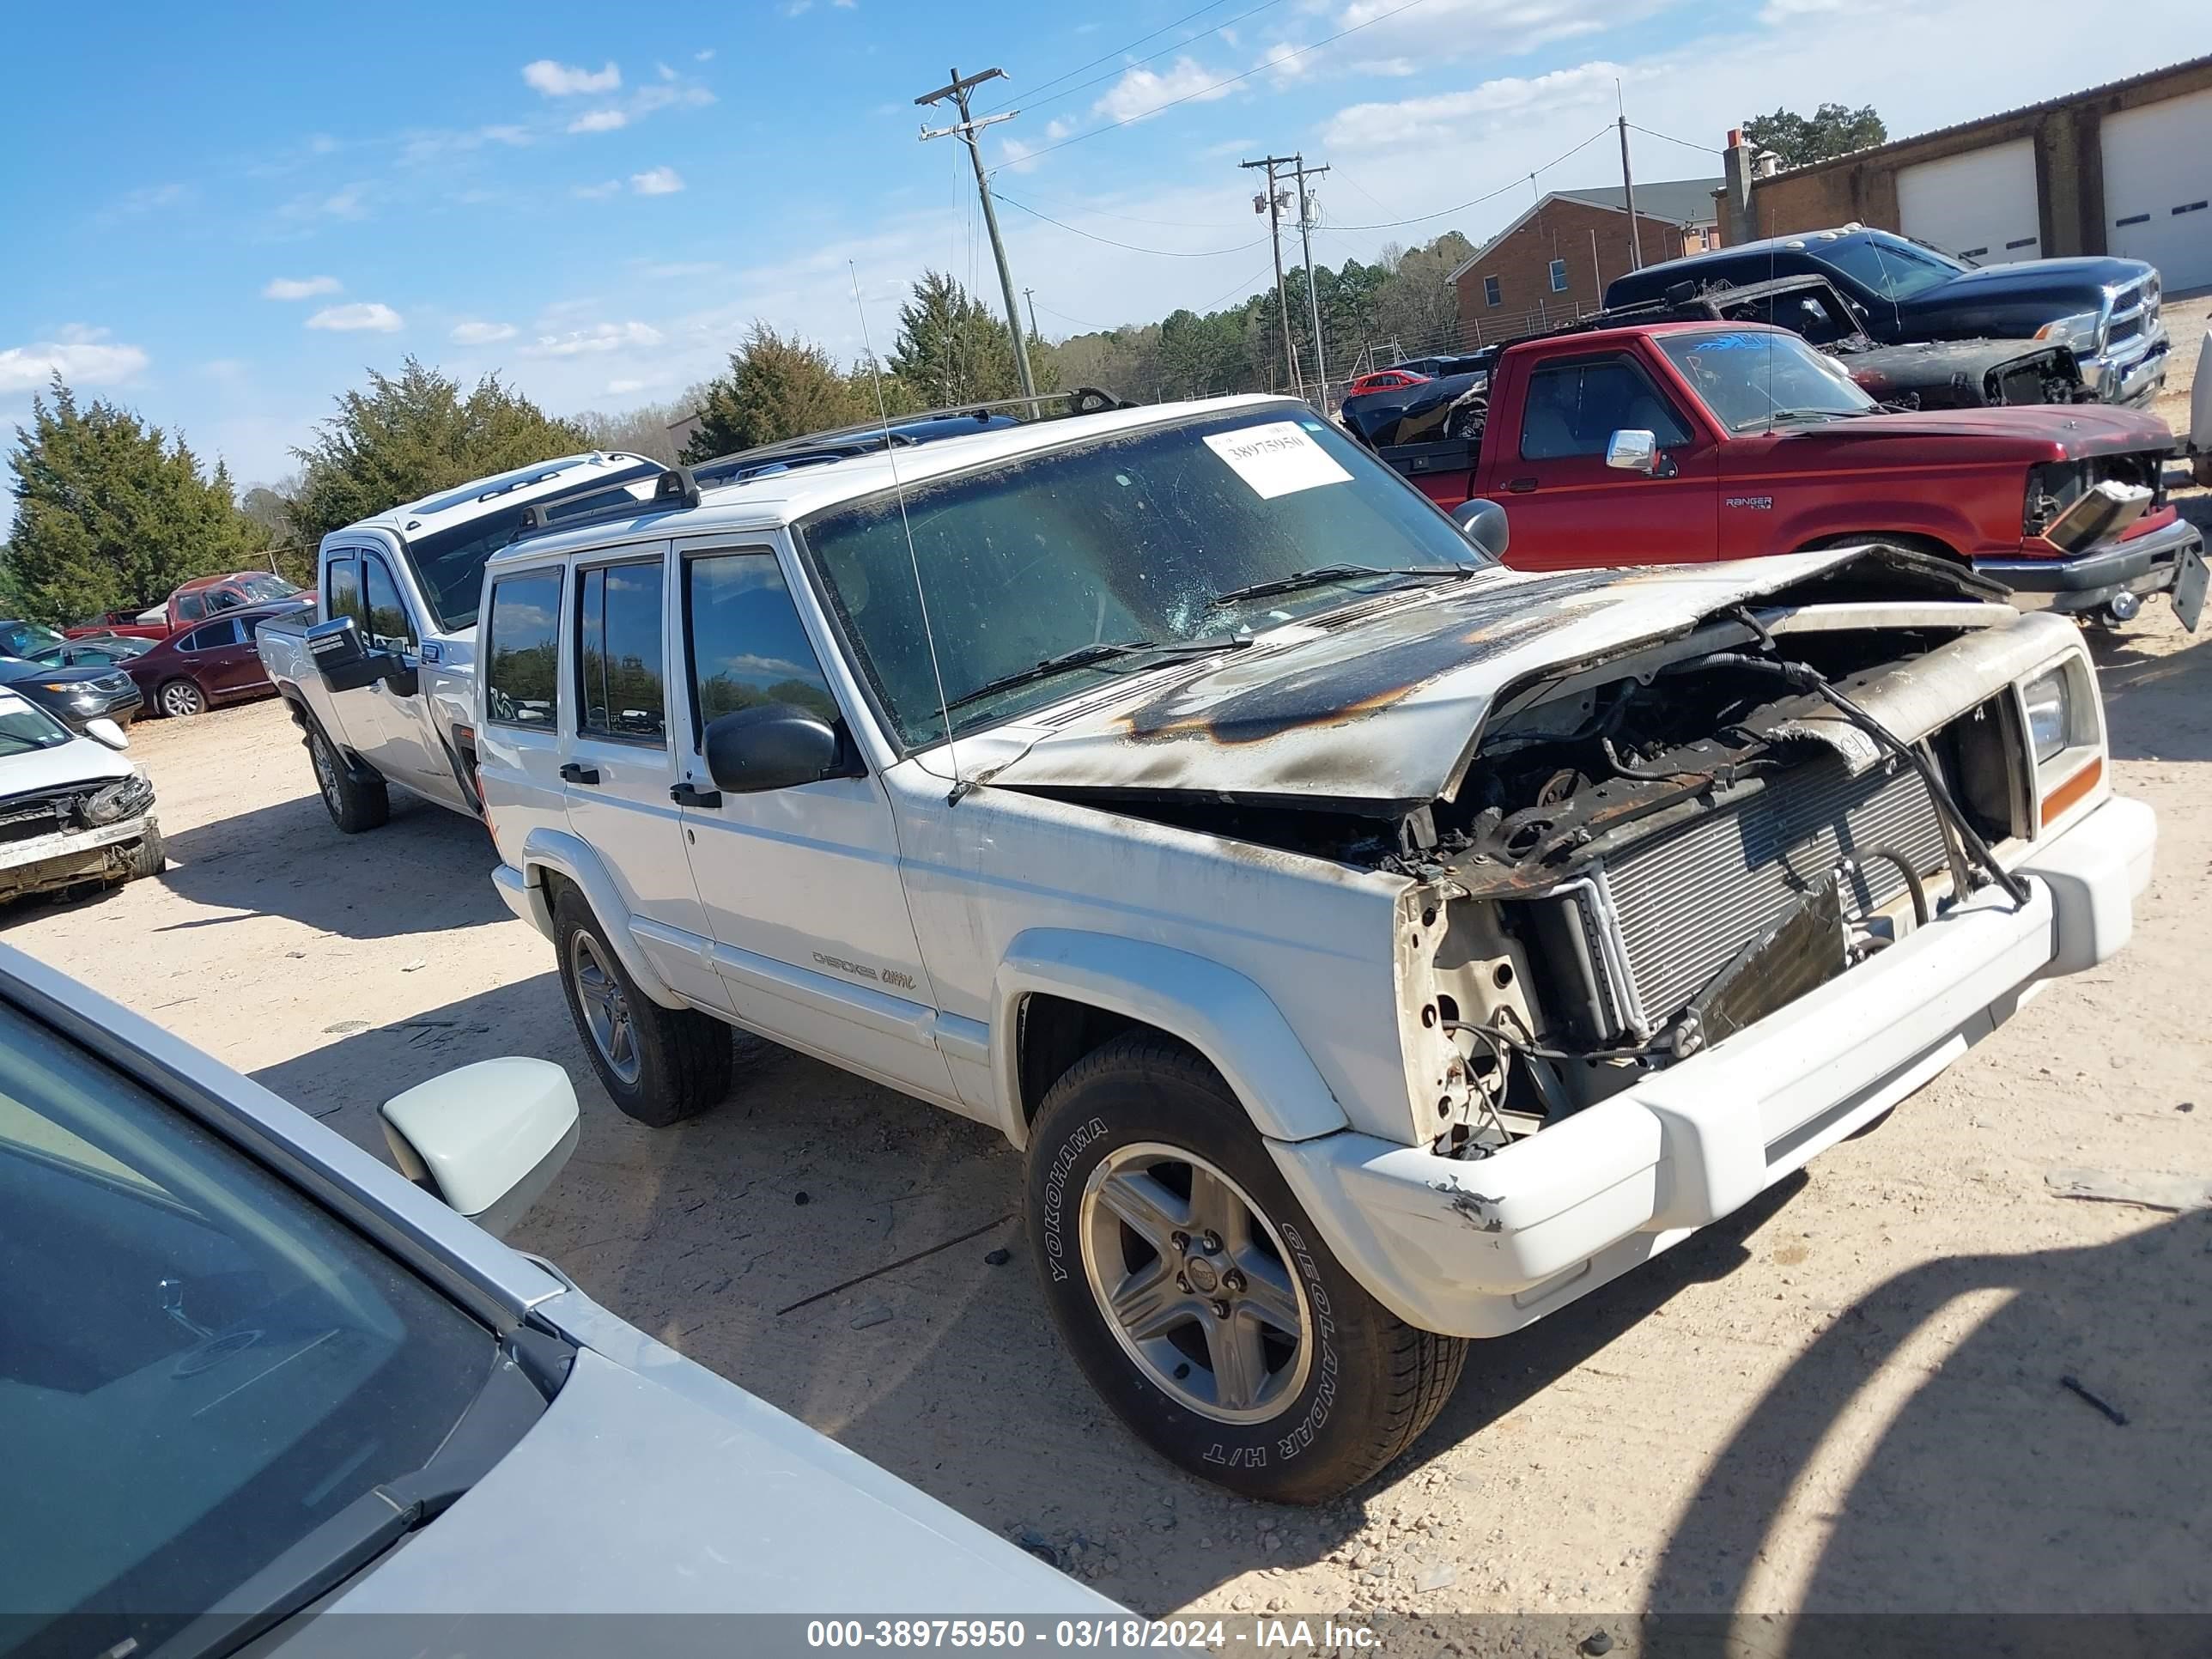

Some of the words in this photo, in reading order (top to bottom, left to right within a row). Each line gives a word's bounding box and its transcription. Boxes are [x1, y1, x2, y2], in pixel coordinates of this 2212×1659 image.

[1227, 435, 1305, 461] 38975950
[1725, 496, 1773, 508] RANGER
[811, 951, 878, 981] CHEROKEE
[1044, 1116, 1109, 1283] YOKOHAMA
[1278, 1222, 1339, 1461] GEOLANDAR
[1202, 1443, 1267, 1468] H/T
